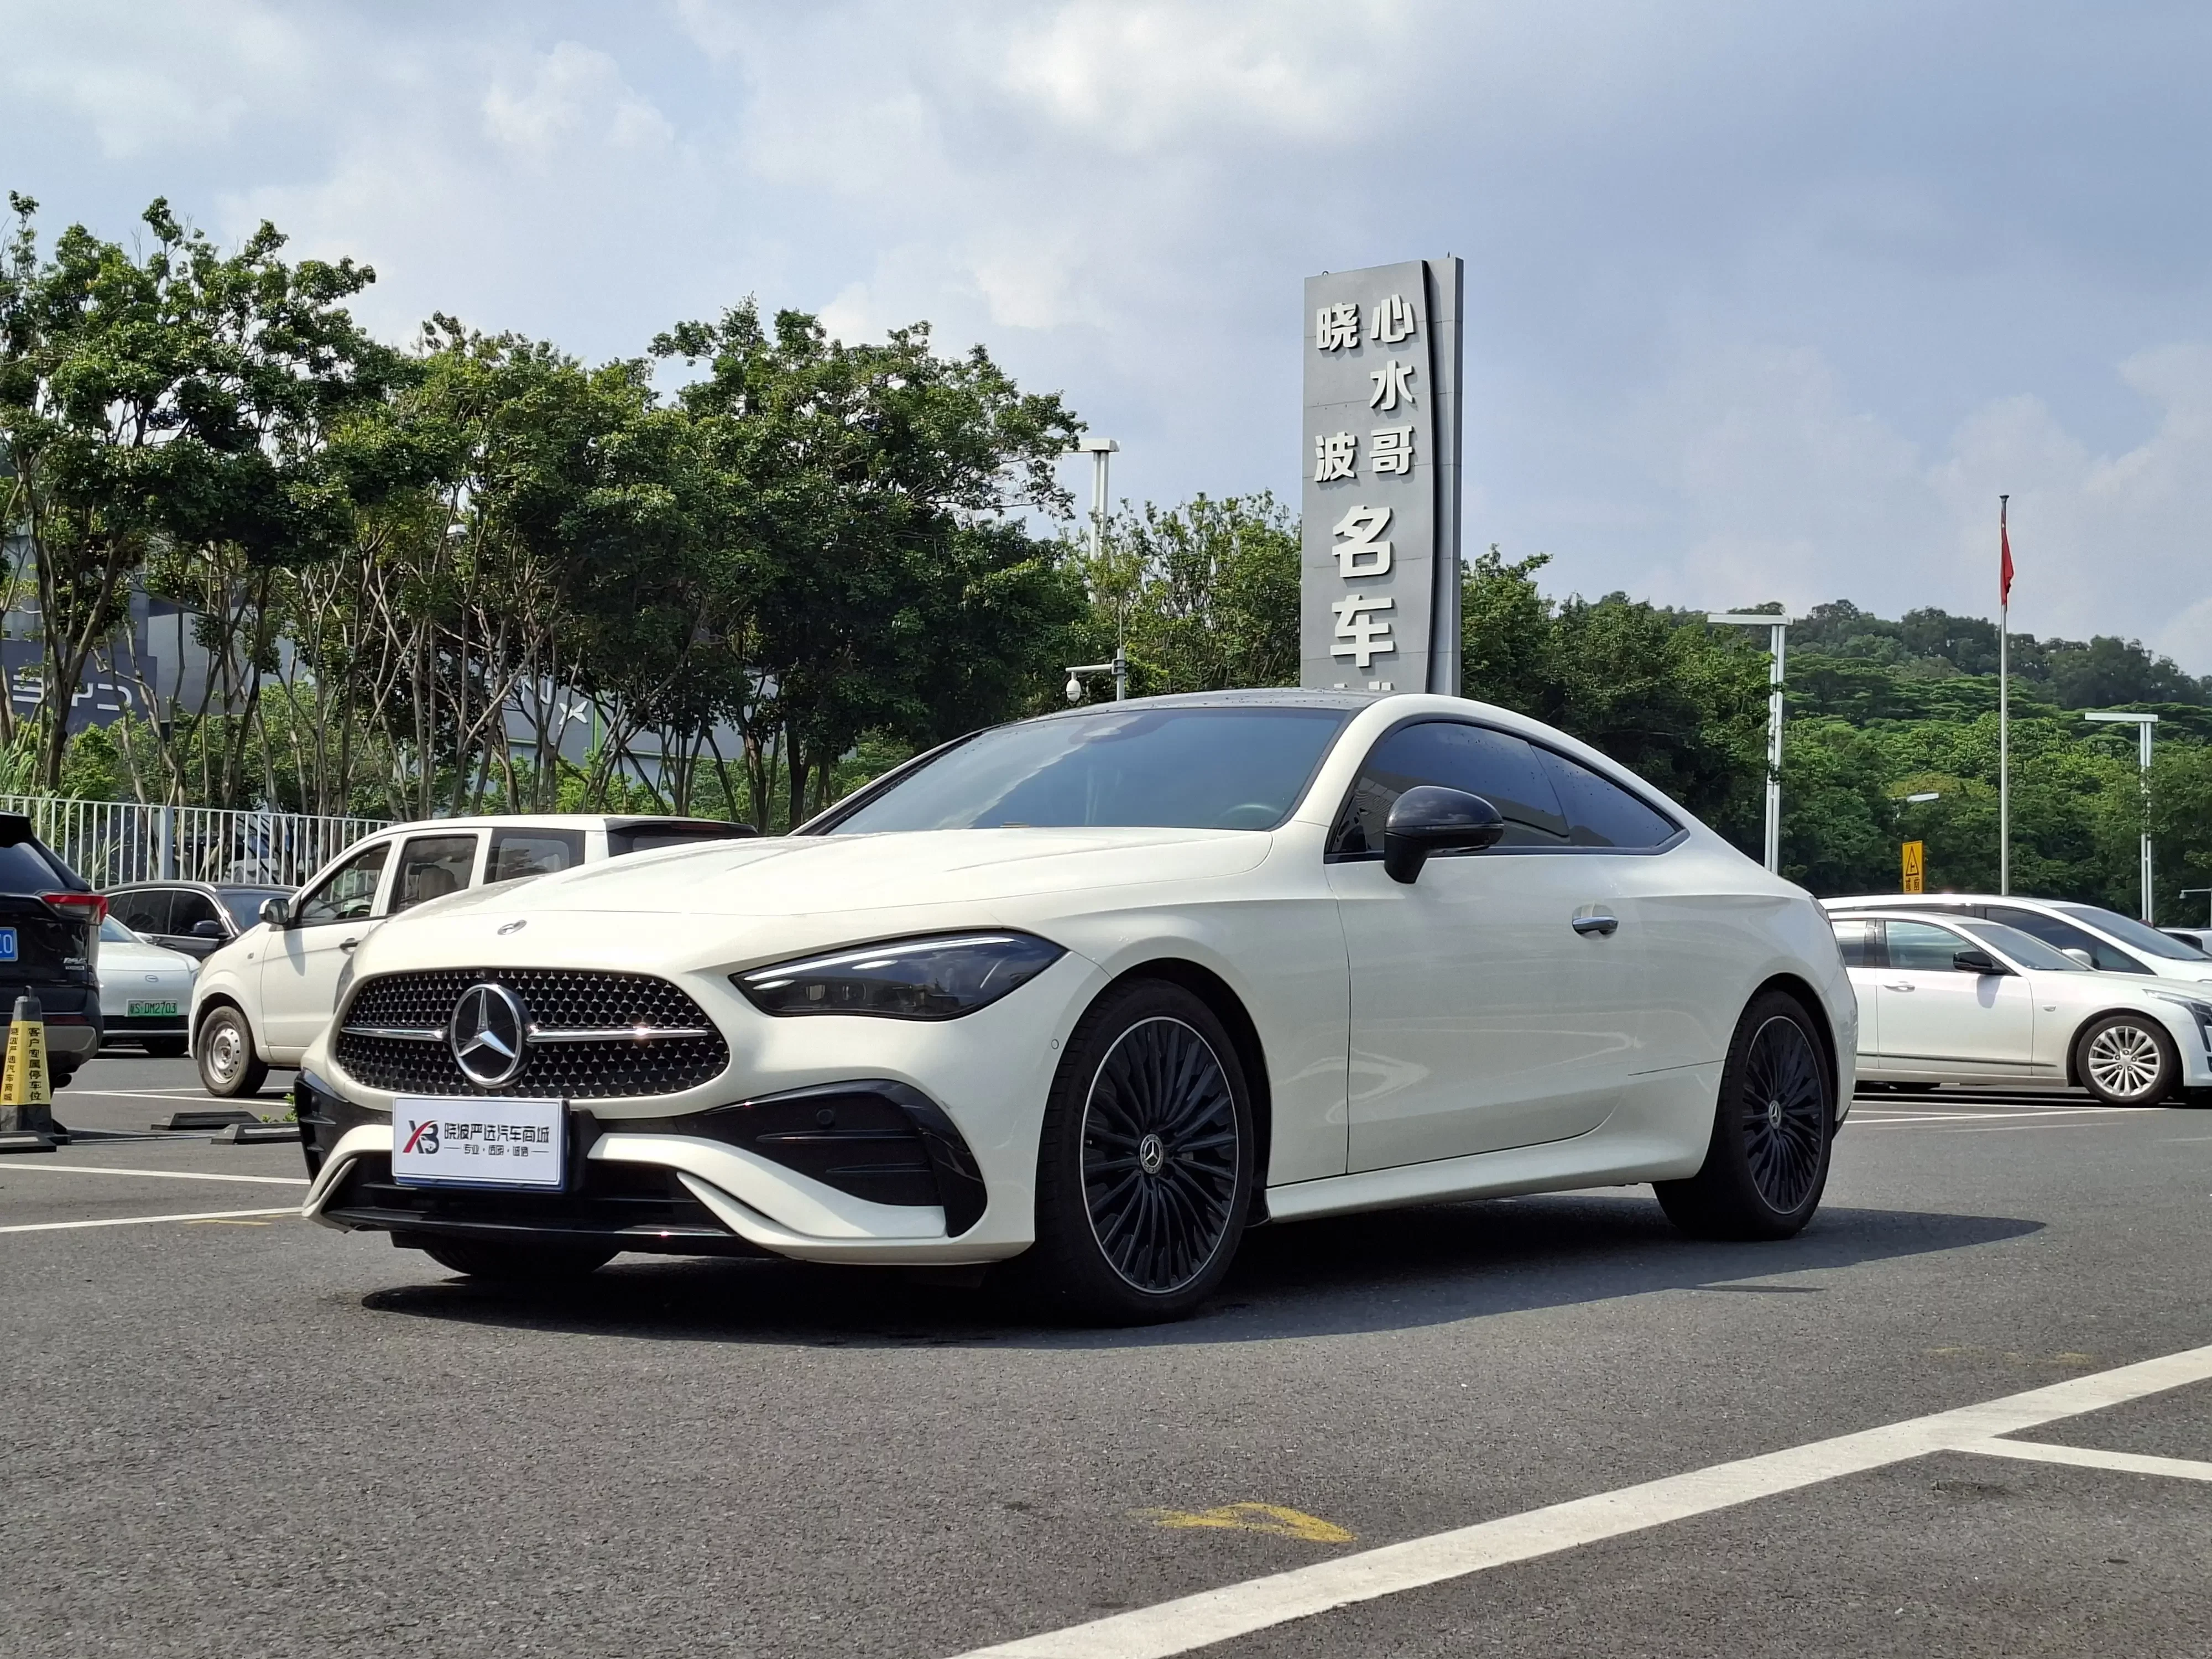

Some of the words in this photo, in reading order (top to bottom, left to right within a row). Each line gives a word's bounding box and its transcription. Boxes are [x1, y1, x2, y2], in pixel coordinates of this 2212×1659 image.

[1314, 302, 1359, 482] 晓波
[1369, 294, 1416, 475] 心水哥
[1331, 505, 1395, 690] 名车
[28, 1027, 42, 1100] 客户专属停车位
[444, 1123, 549, 1143] 晓波严选汽车商城
